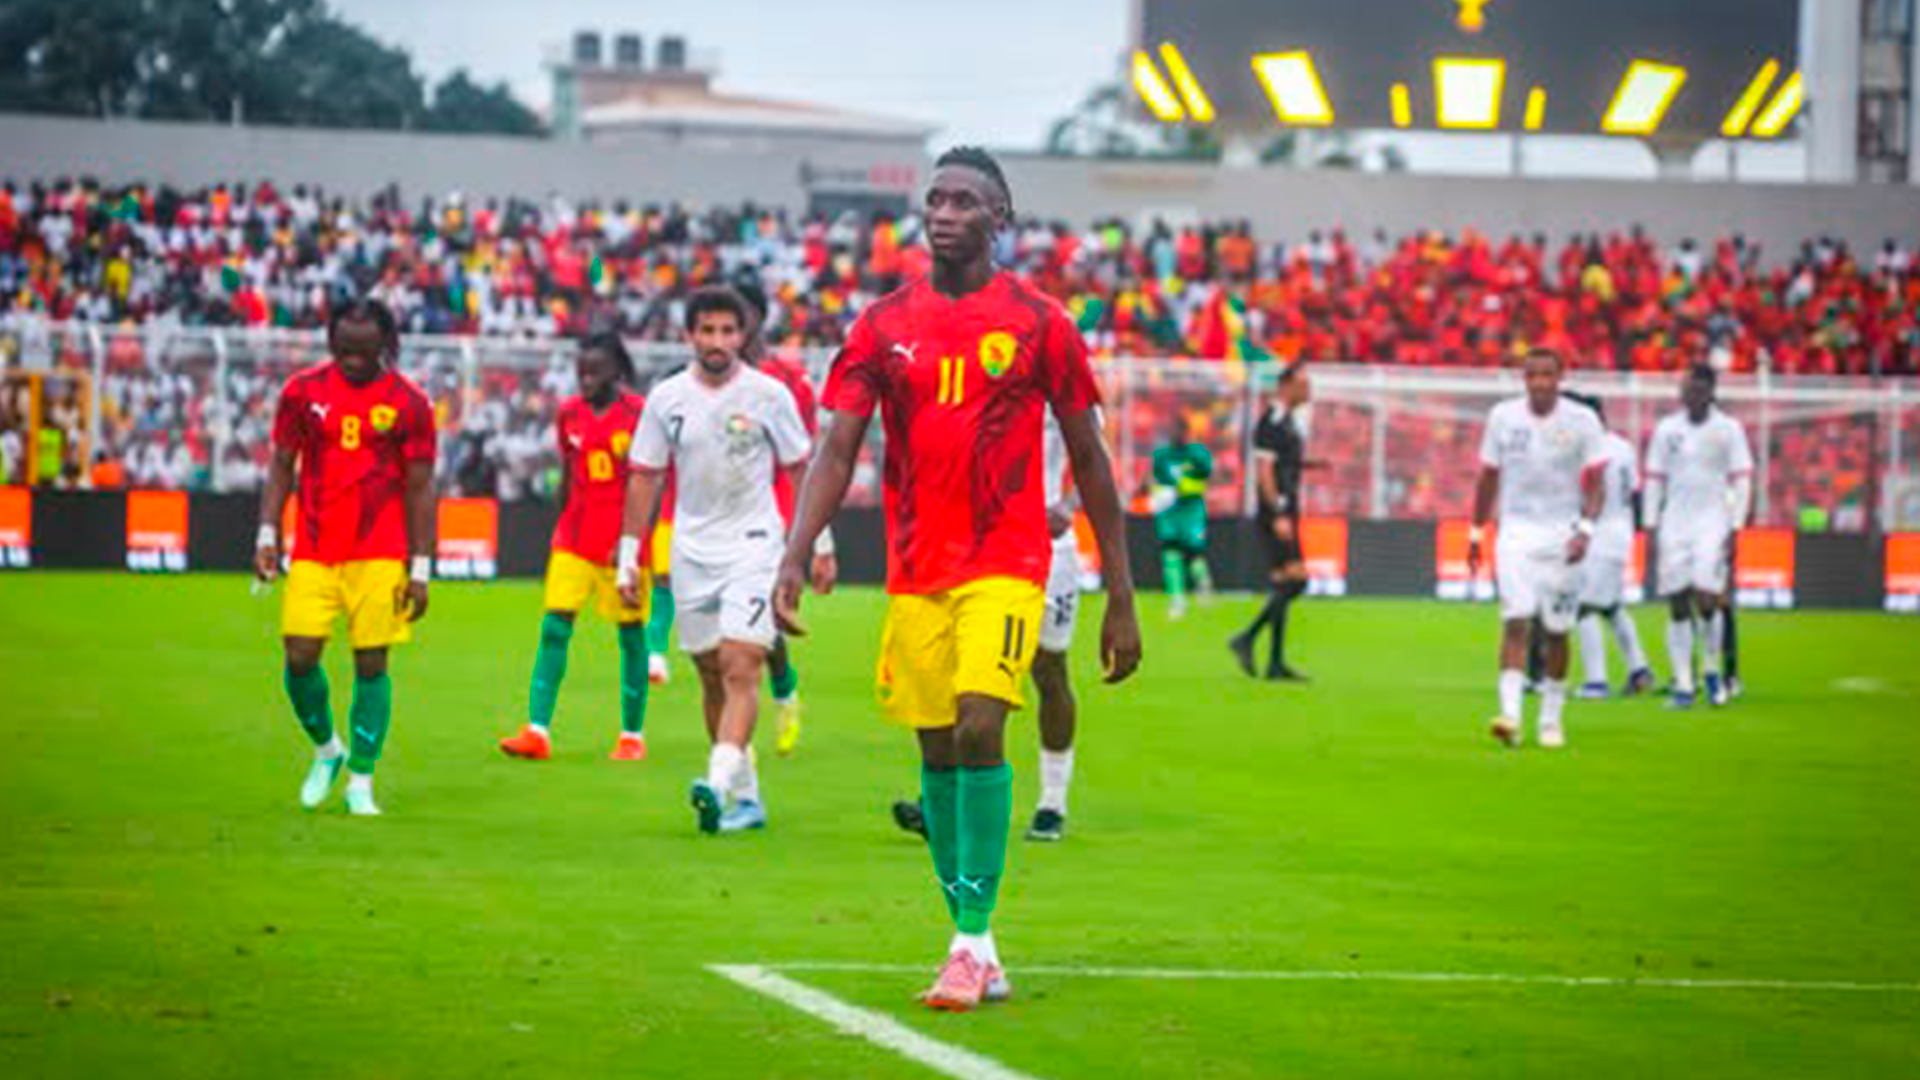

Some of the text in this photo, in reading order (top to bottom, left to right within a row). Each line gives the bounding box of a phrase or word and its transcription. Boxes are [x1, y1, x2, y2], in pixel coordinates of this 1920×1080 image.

[938, 355, 965, 404] 11
[341, 414, 361, 451] 8
[668, 415, 684, 445] 7
[587, 449, 614, 481] 10
[747, 596, 766, 628] 7
[1002, 614, 1025, 662] 11
